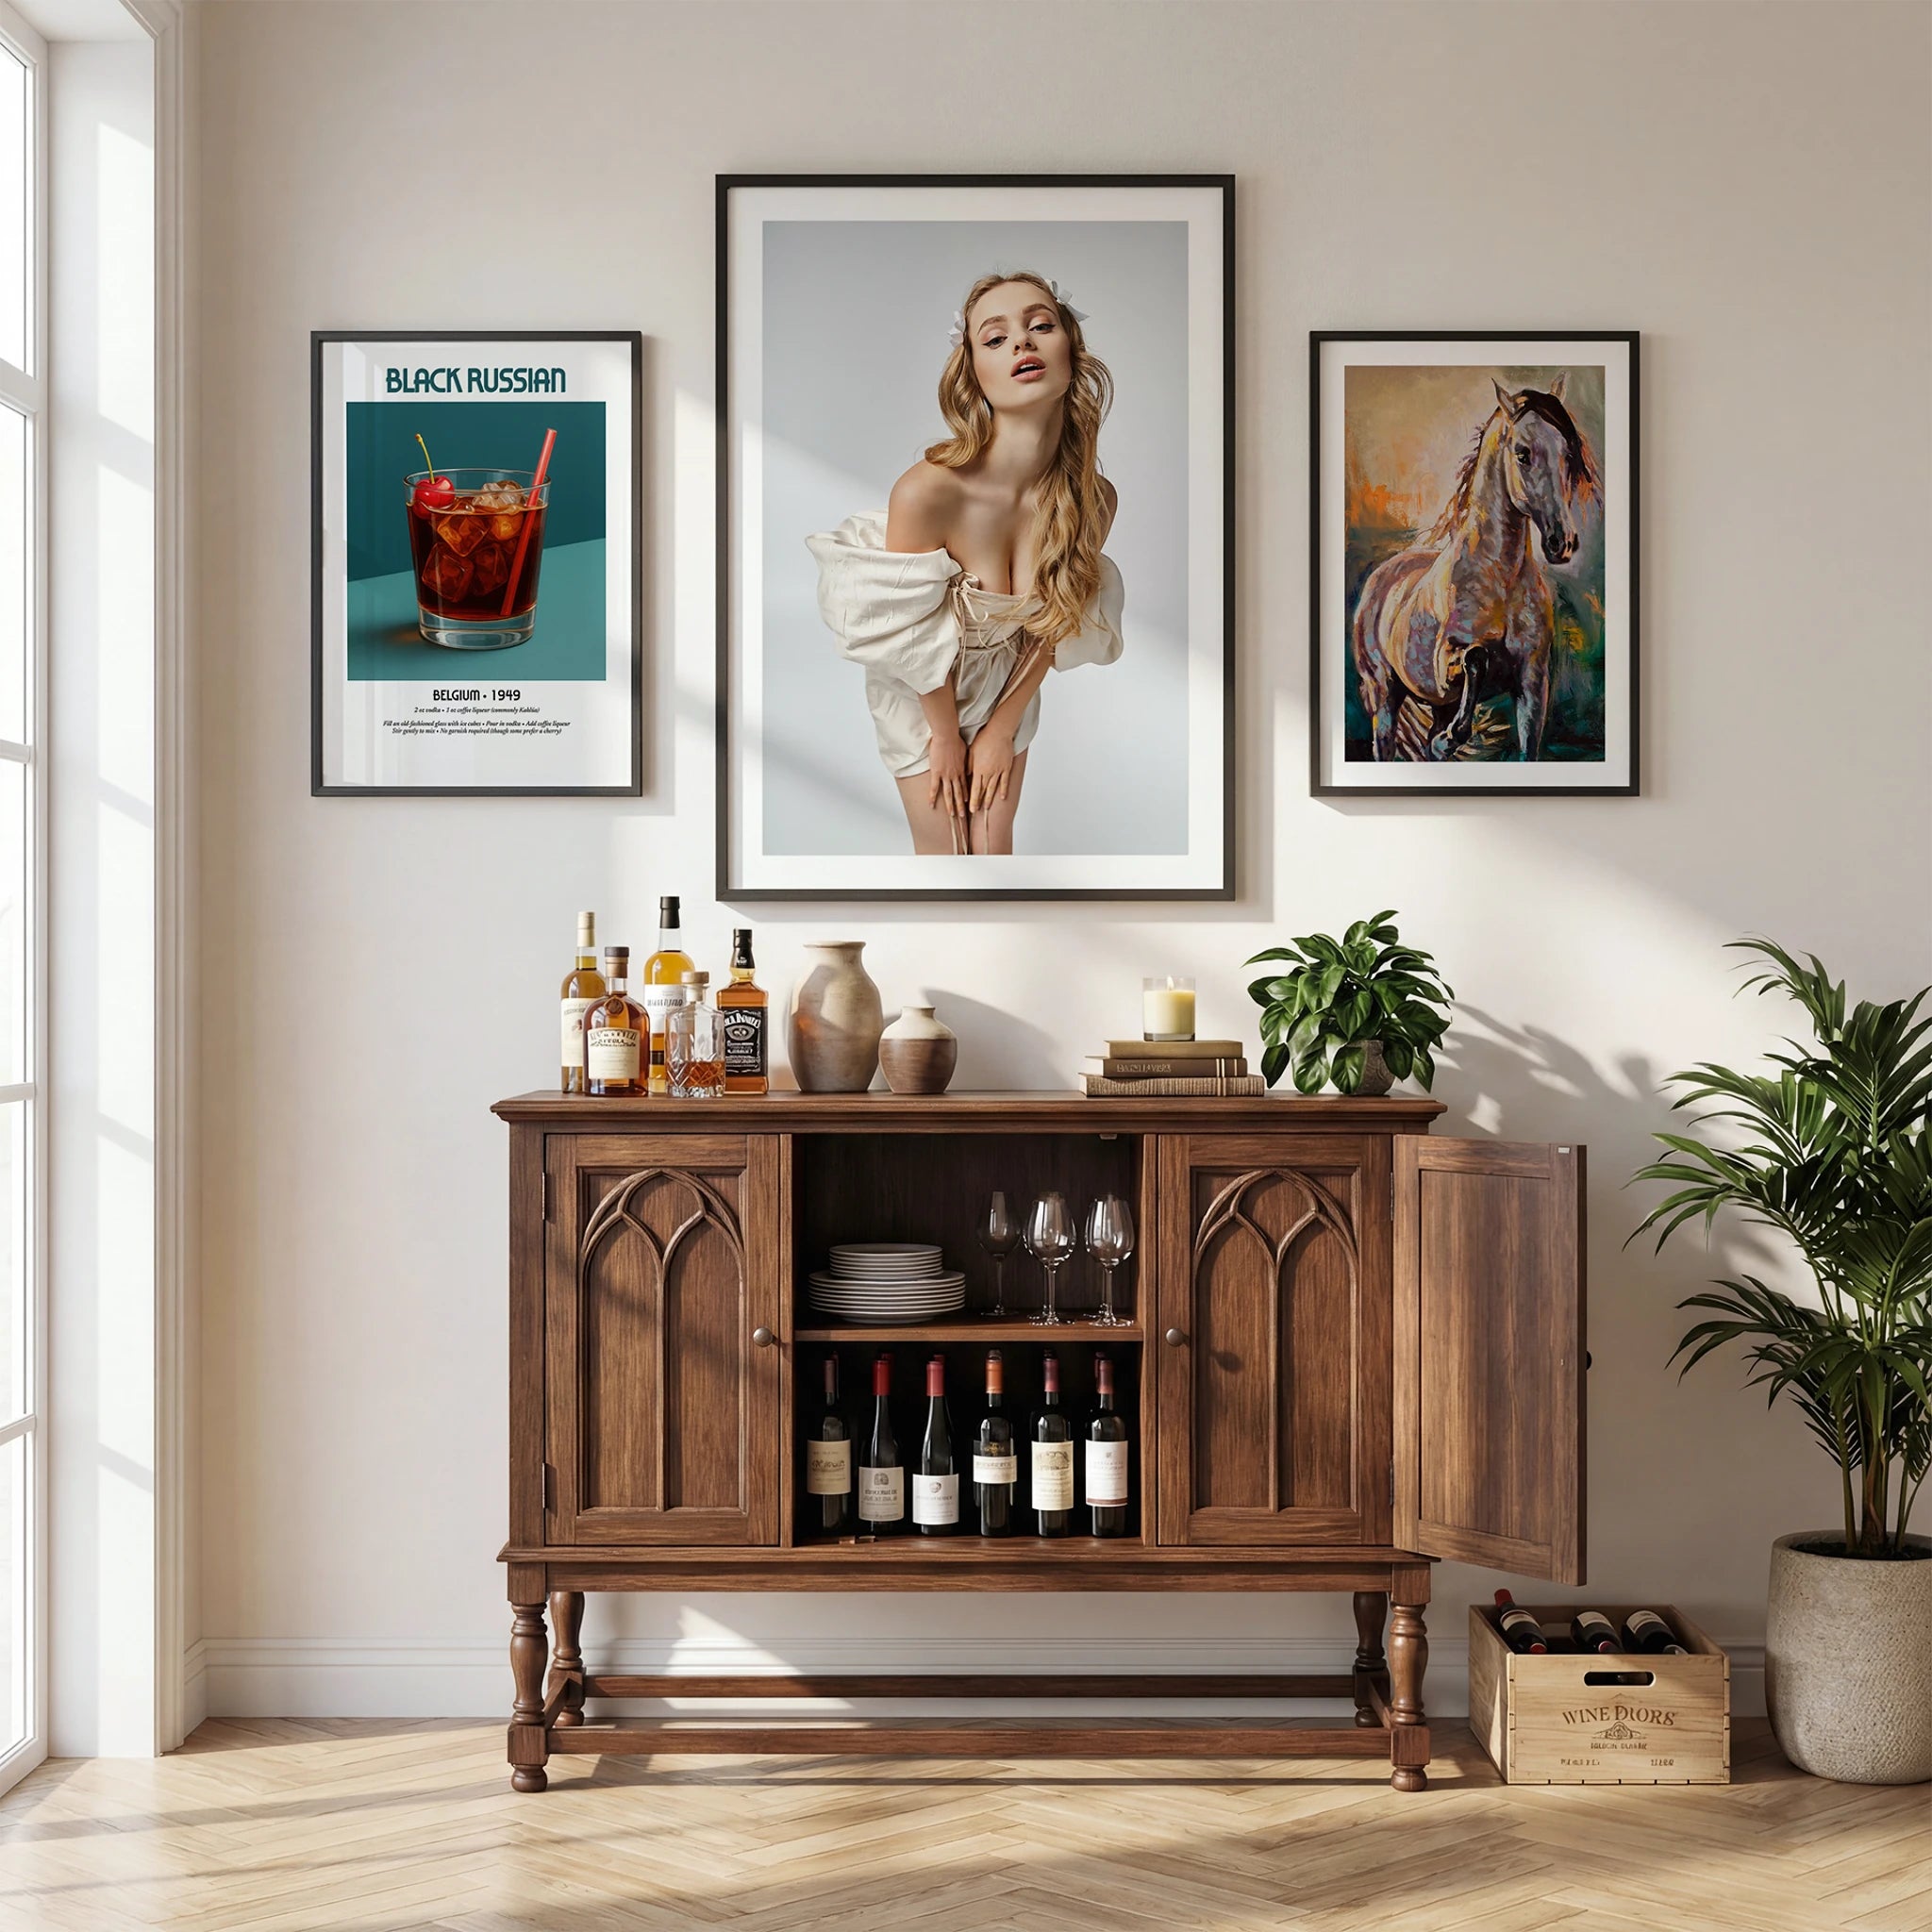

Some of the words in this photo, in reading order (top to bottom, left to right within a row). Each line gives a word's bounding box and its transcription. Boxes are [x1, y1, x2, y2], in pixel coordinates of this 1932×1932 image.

[385, 367, 462, 393] BLACK
[467, 367, 566, 393] RUSSIAN
[432, 689, 480, 701] BELGIUM
[491, 689, 521, 701] 1949
[1562, 1707, 1610, 1725] WINE
